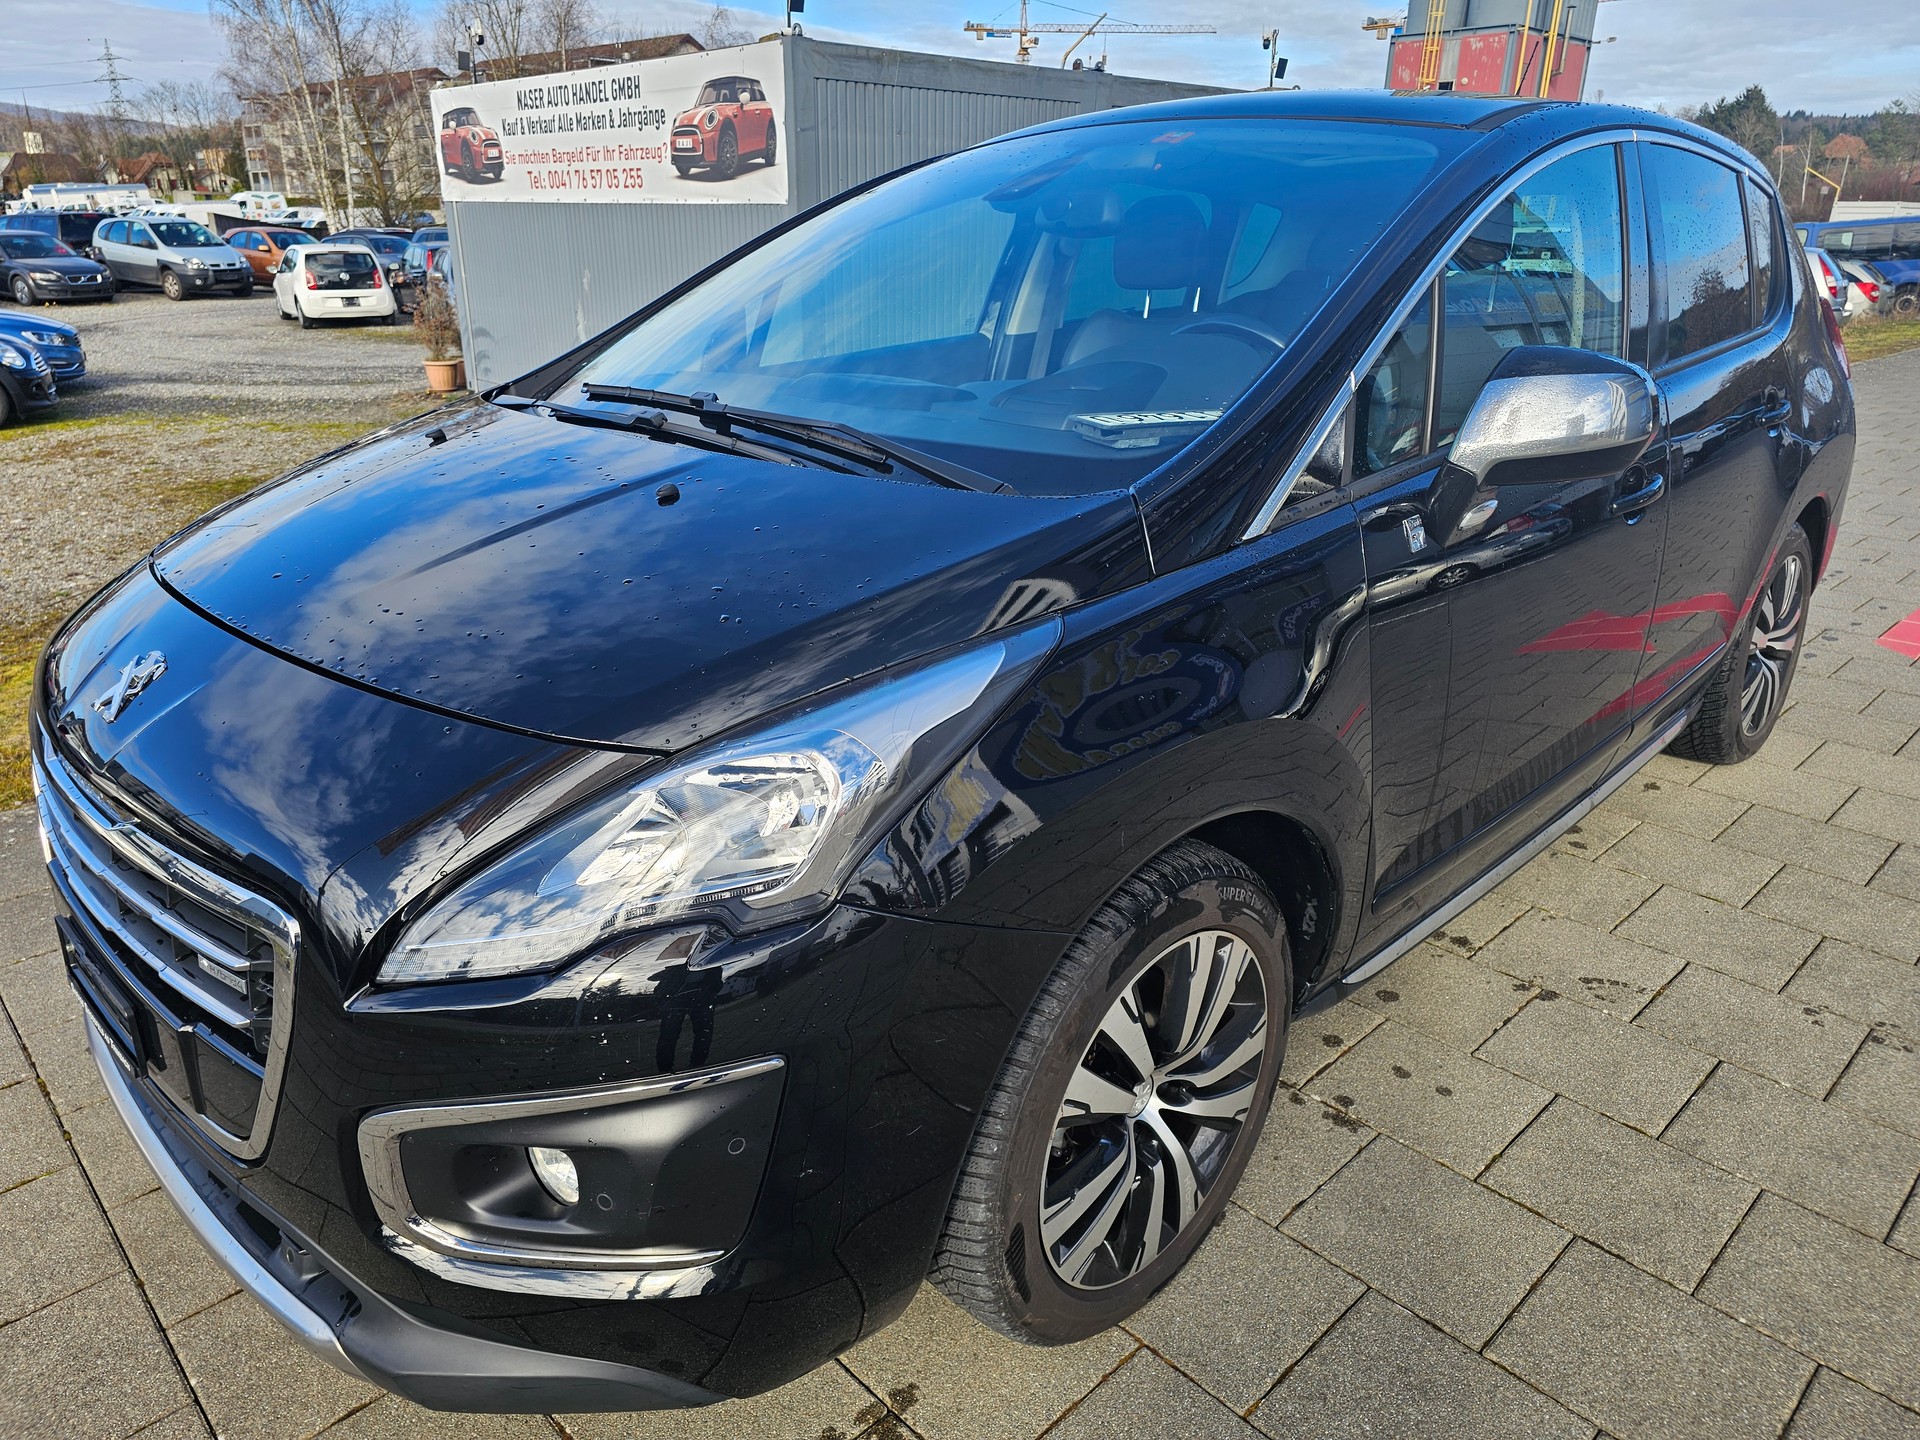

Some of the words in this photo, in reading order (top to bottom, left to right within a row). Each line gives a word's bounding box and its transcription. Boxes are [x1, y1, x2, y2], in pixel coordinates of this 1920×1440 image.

[517, 88, 545, 111] NASER
[547, 84, 570, 109] AUTO
[571, 80, 609, 106] HANDEL
[611, 75, 641, 102] GMBH
[502, 117, 519, 137] Kauf
[520, 116, 526, 136] &
[526, 114, 556, 135] Verkauf
[558, 112, 574, 133] Alle
[575, 110, 607, 132] Marken
[608, 108, 616, 129] &
[617, 105, 667, 132] Jahrgänge
[505, 150, 517, 165] Sie
[518, 149, 551, 165] möchten
[552, 147, 584, 167] Bargeld
[586, 145, 601, 163] Für
[602, 145, 616, 162] Ihr
[618, 142, 668, 164] Fahrzeug?
[527, 170, 547, 190] Tel:
[548, 169, 573, 190] 0041
[574, 169, 589, 190] 76
[590, 169, 603, 190] 57
[606, 168, 620, 189] 05
[622, 167, 644, 189] 255
